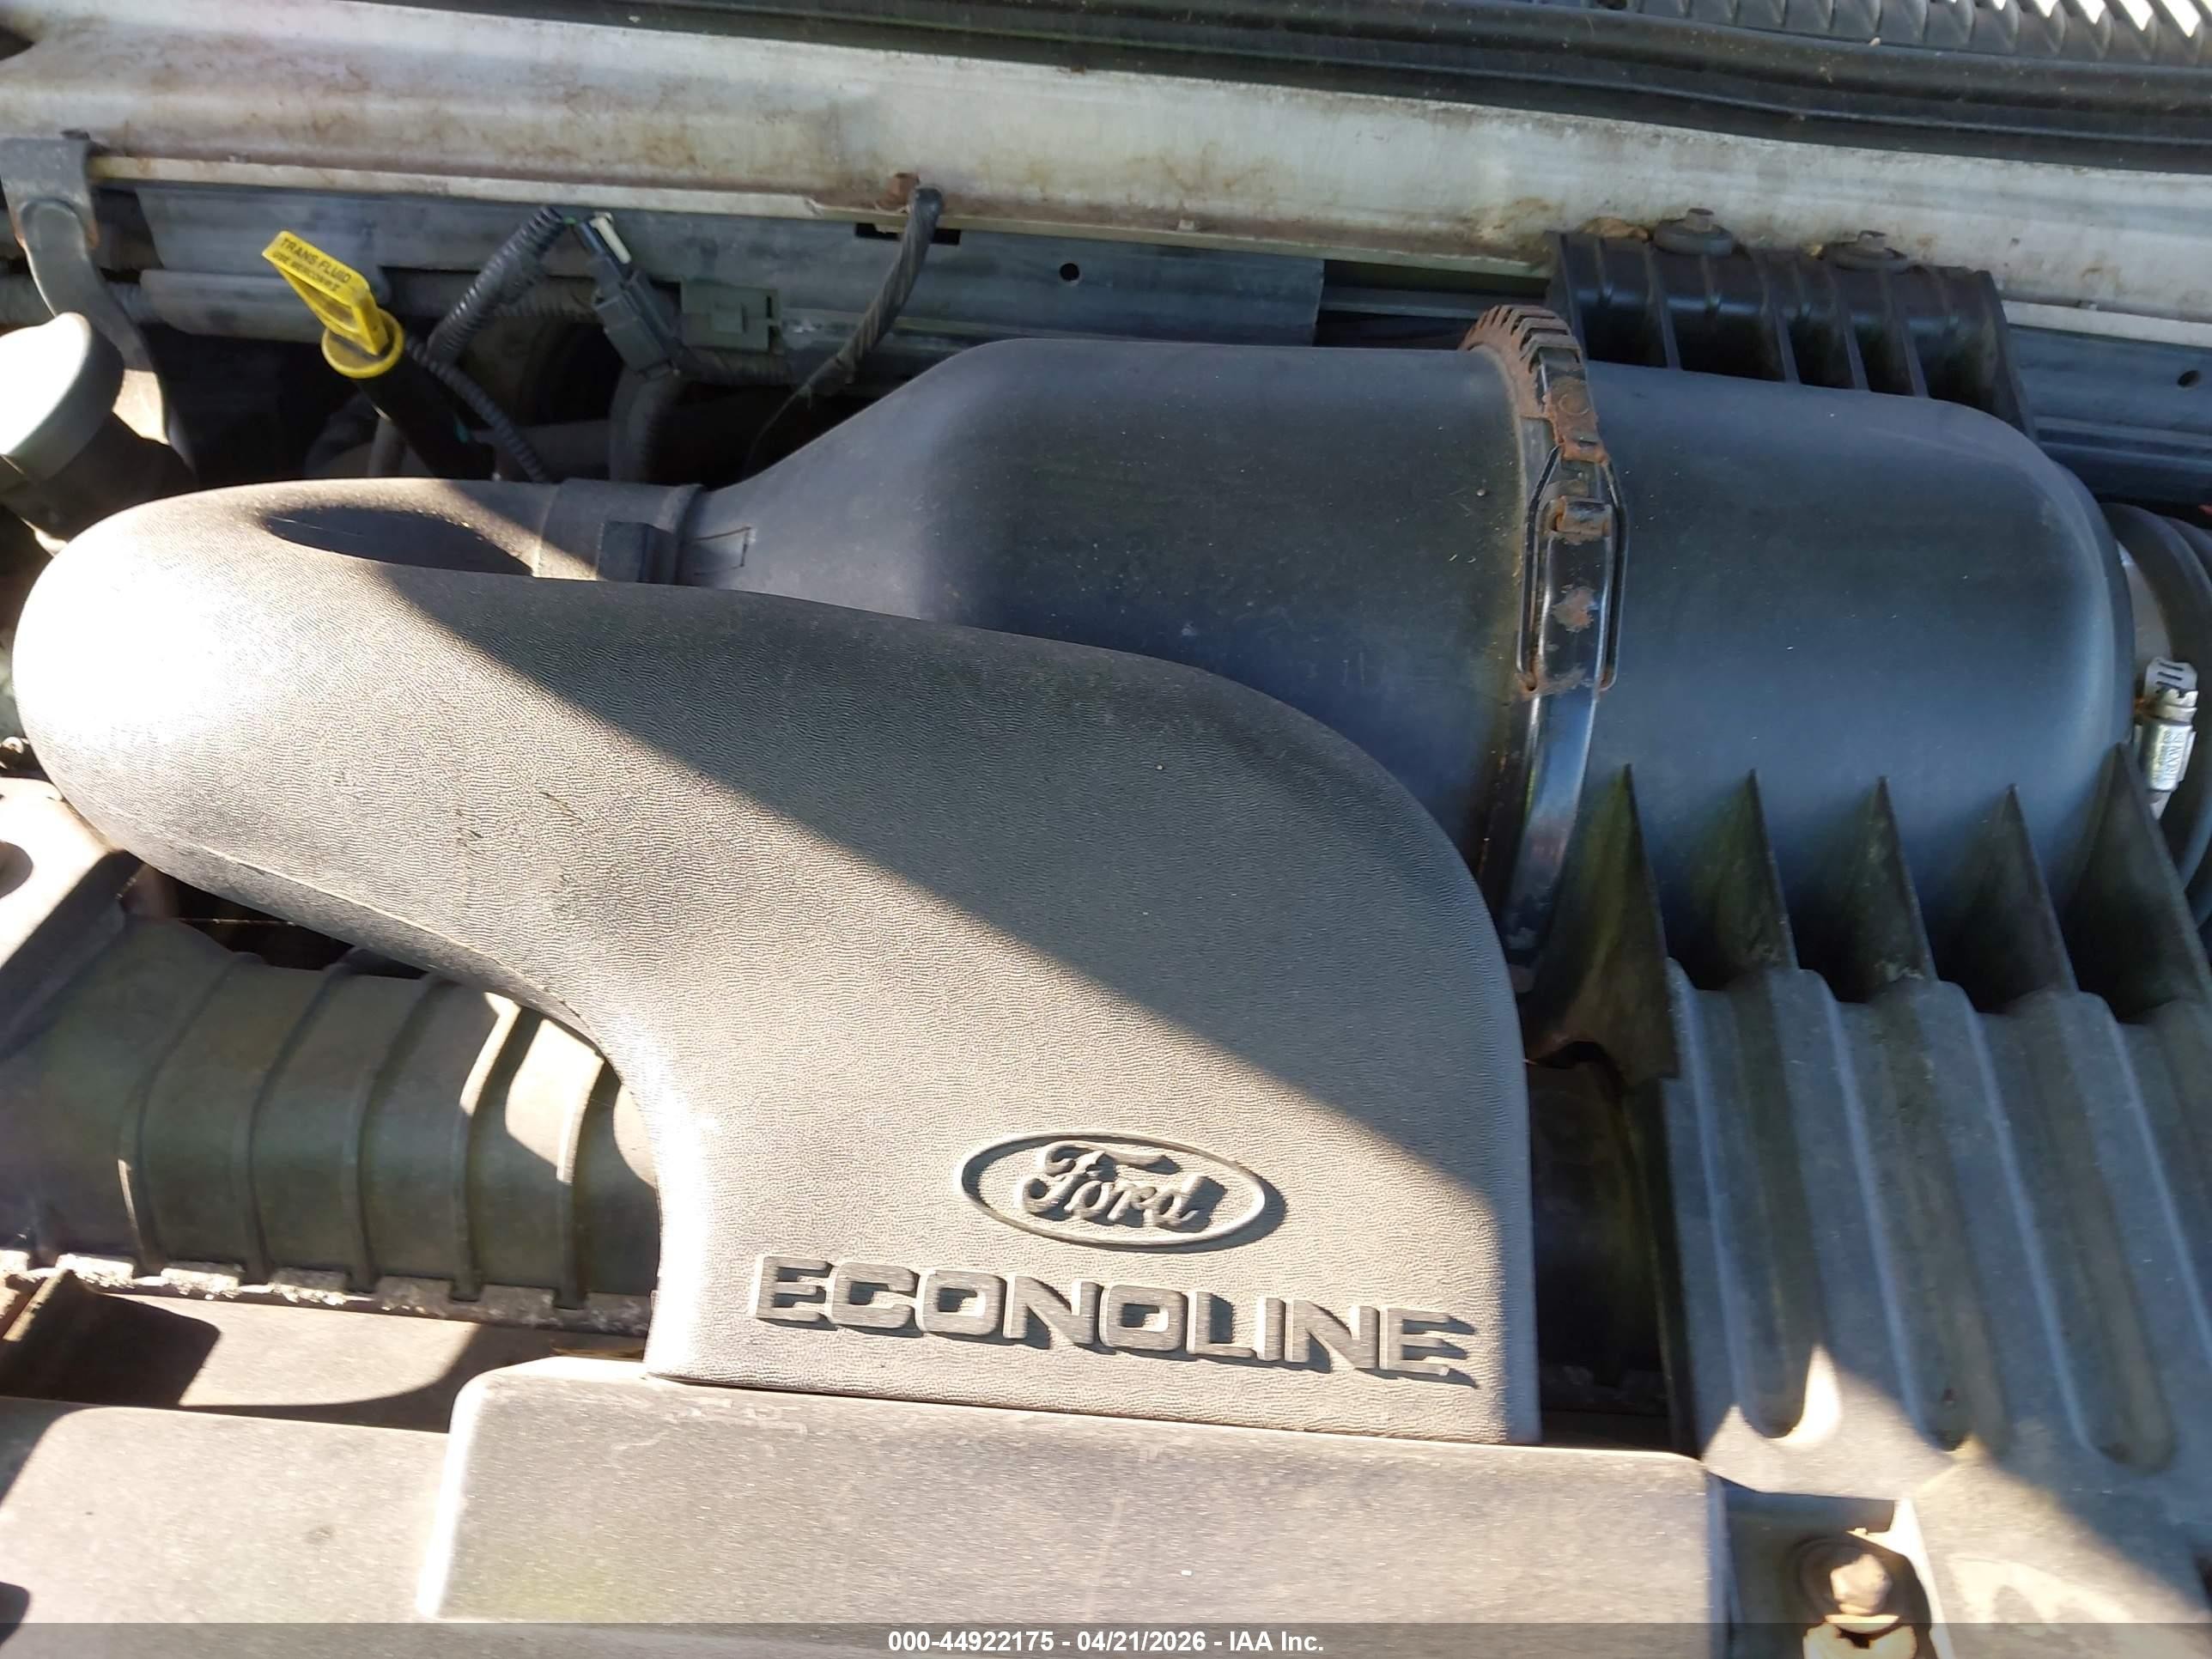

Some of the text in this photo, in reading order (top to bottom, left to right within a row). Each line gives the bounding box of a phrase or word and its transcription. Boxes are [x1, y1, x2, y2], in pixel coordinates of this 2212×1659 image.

[281, 238, 319, 264] TRANS
[318, 260, 351, 283] FLUID
[1022, 1139, 1202, 1227] Ford
[750, 1255, 1467, 1377] ECONOLINE
